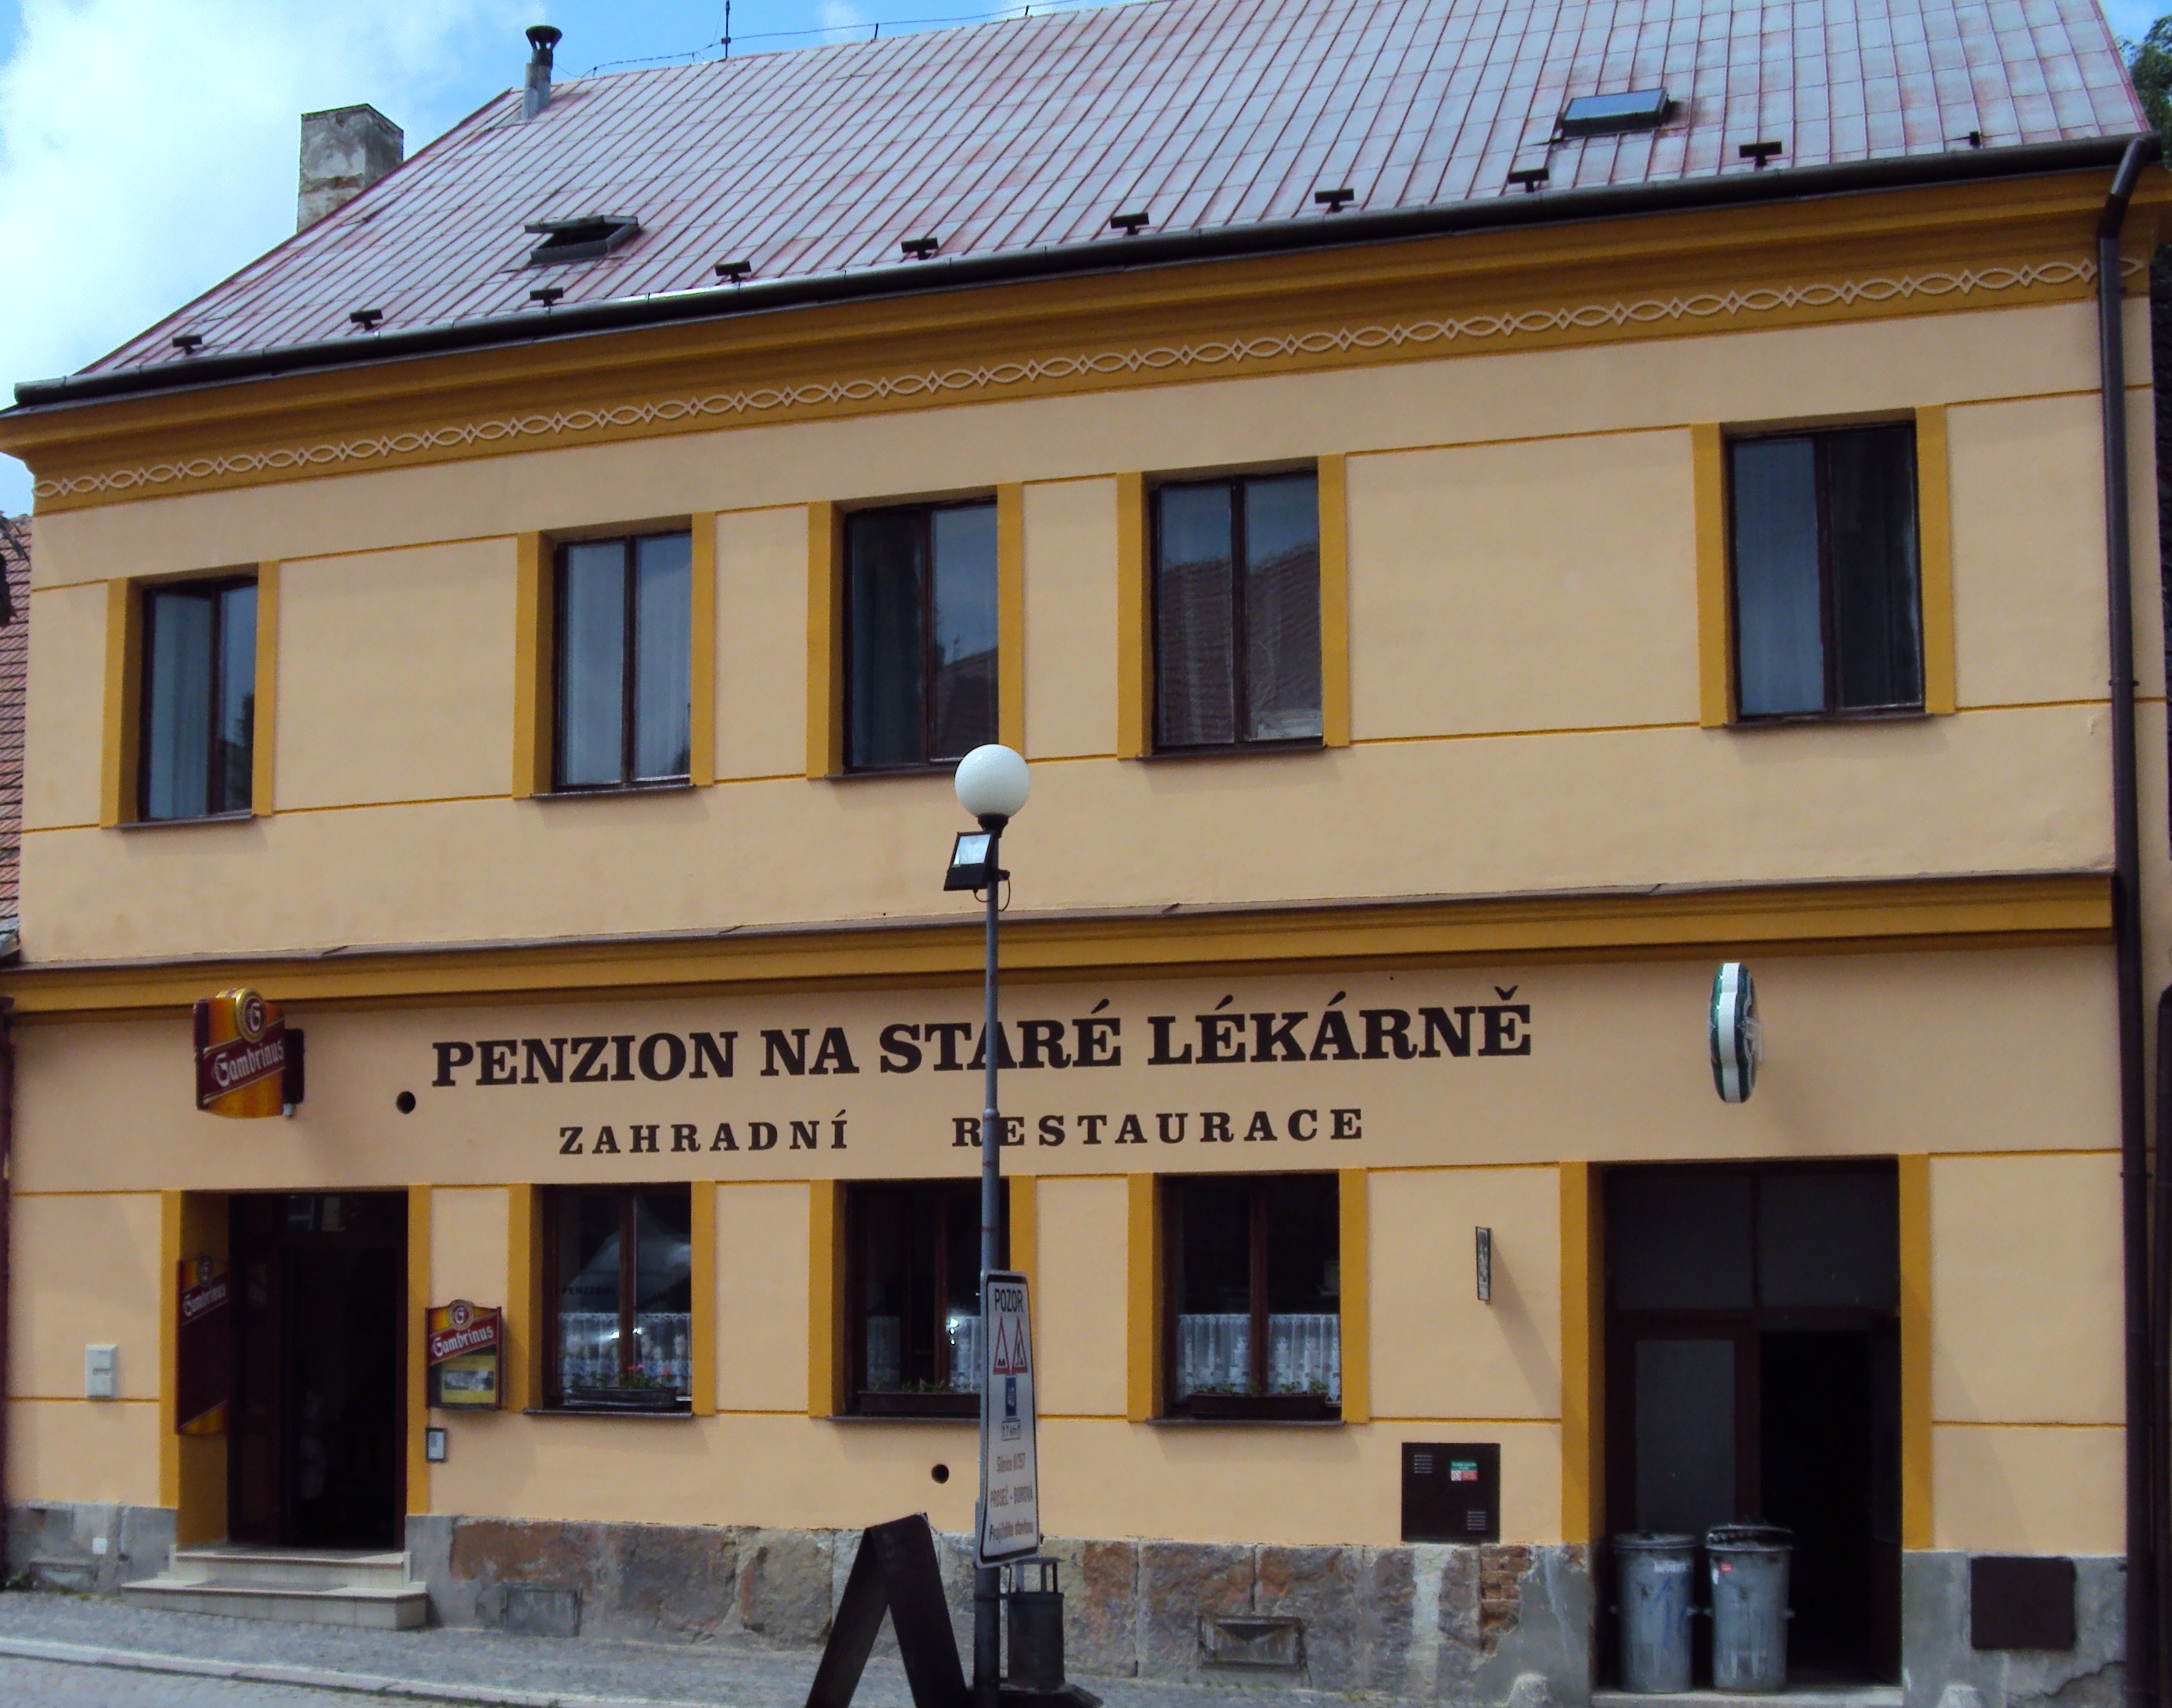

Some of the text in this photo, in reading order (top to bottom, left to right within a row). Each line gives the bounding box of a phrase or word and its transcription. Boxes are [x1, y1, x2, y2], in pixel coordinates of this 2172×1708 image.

[431, 985, 1532, 1087] PENZION NA STARÉ LÉKÁRNĚ
[212, 1040, 284, 1087] Gambrinus
[558, 1108, 1364, 1155] ZAHRADNÍ RESTAURACE
[994, 1289, 1024, 1313] POZOR
[432, 1326, 494, 1357] Gambrinus
